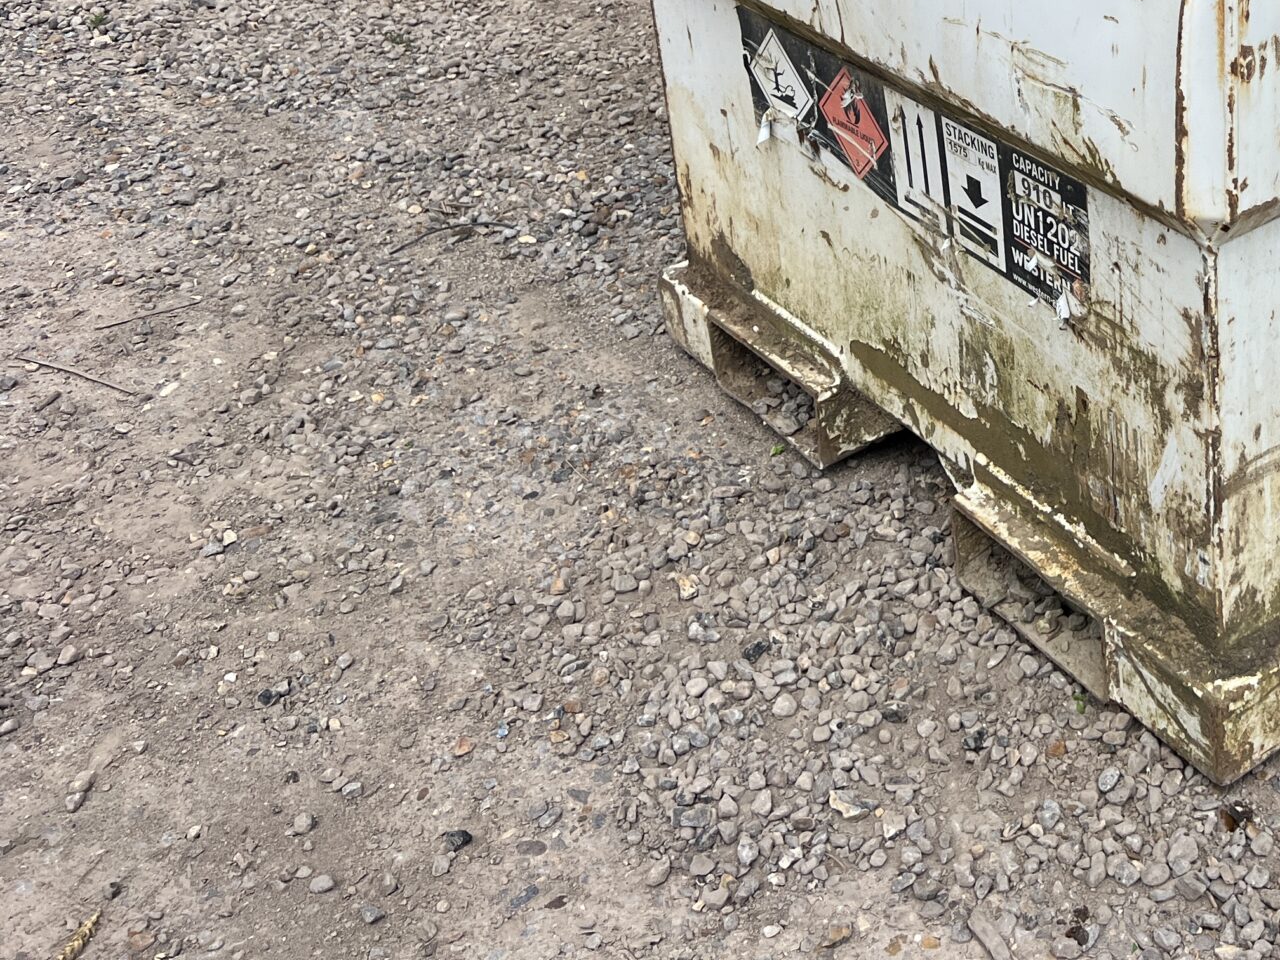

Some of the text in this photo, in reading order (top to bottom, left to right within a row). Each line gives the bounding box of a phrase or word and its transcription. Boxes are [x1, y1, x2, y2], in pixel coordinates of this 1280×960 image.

[945, 122, 995, 160] STACKING
[949, 141, 968, 158] 1575
[1012, 152, 1061, 191] CAPACITY
[1021, 177, 1054, 210] 910
[1011, 197, 1081, 257] UN1202
[1013, 218, 1082, 275] DIESEL FUEL
